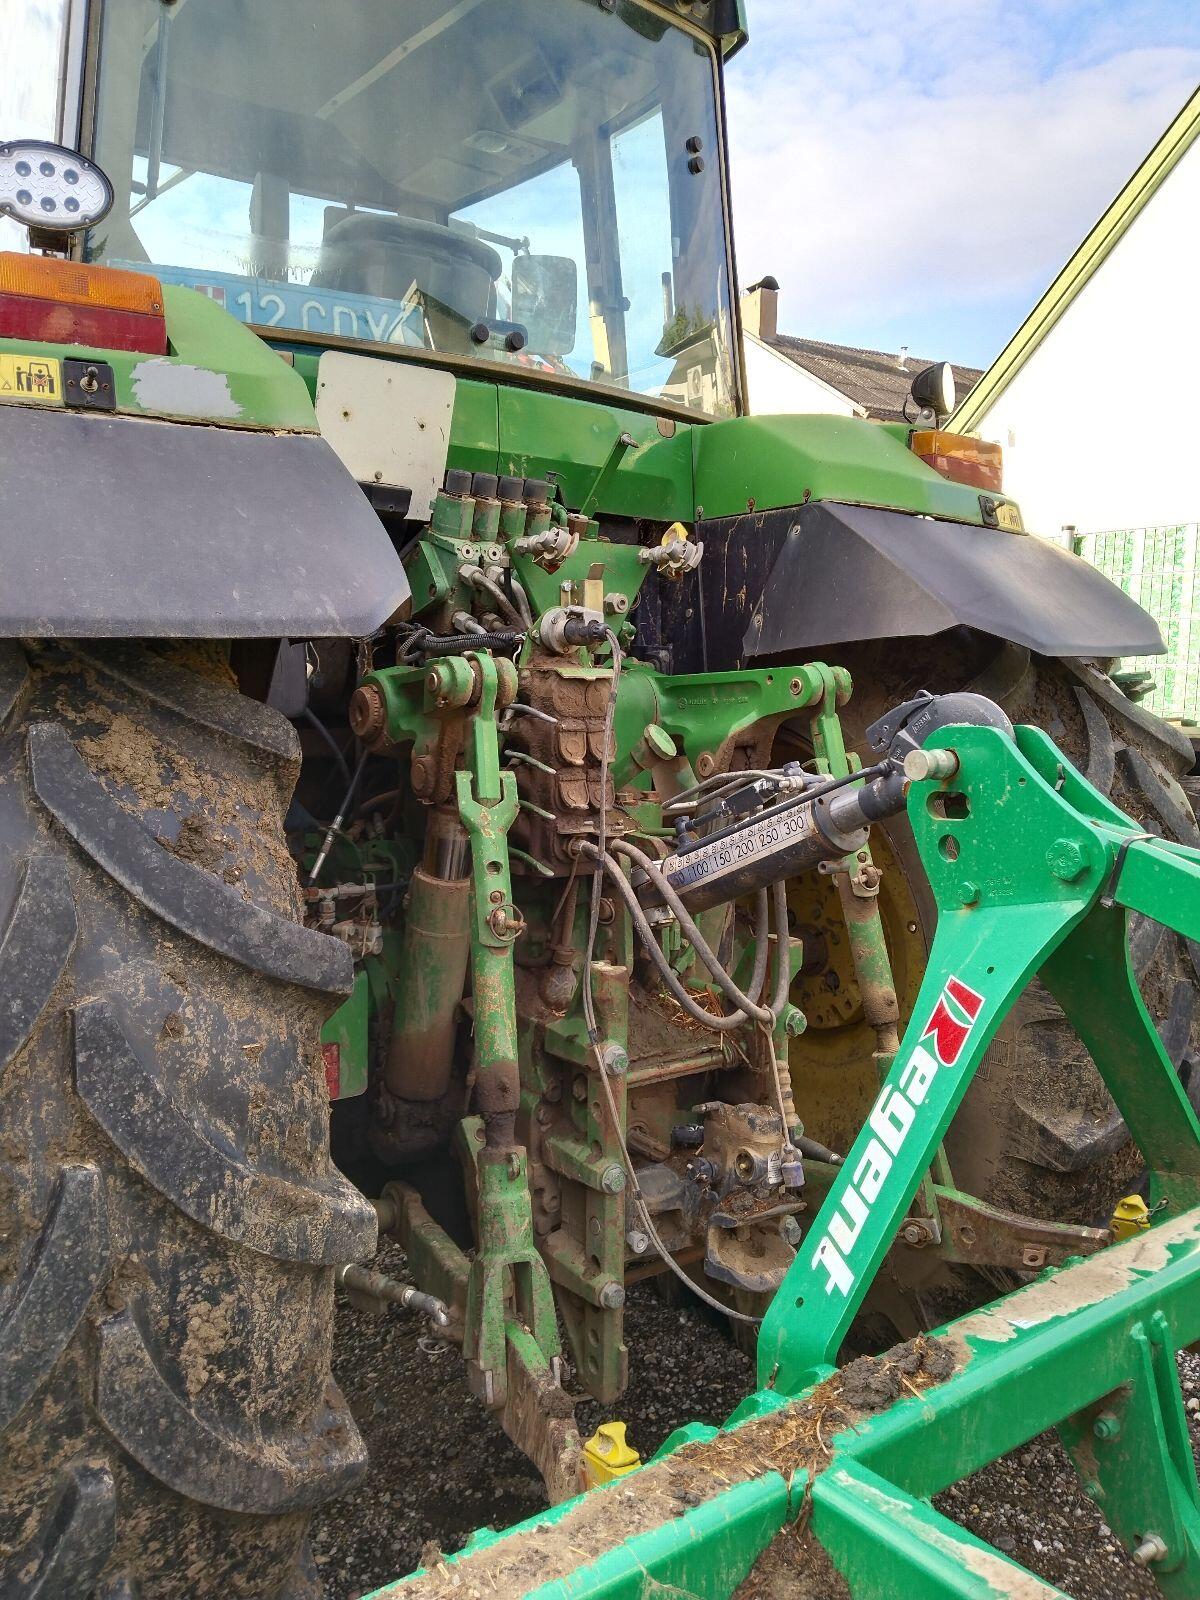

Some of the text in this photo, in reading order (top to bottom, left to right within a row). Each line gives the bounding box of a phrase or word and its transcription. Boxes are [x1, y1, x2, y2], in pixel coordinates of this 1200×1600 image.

[692, 861, 709, 877] 100
[713, 851, 731, 866] 150
[736, 839, 754, 857] 200
[758, 828, 779, 847] 250
[783, 816, 804, 835] 300
[812, 975, 985, 1297] Regent
